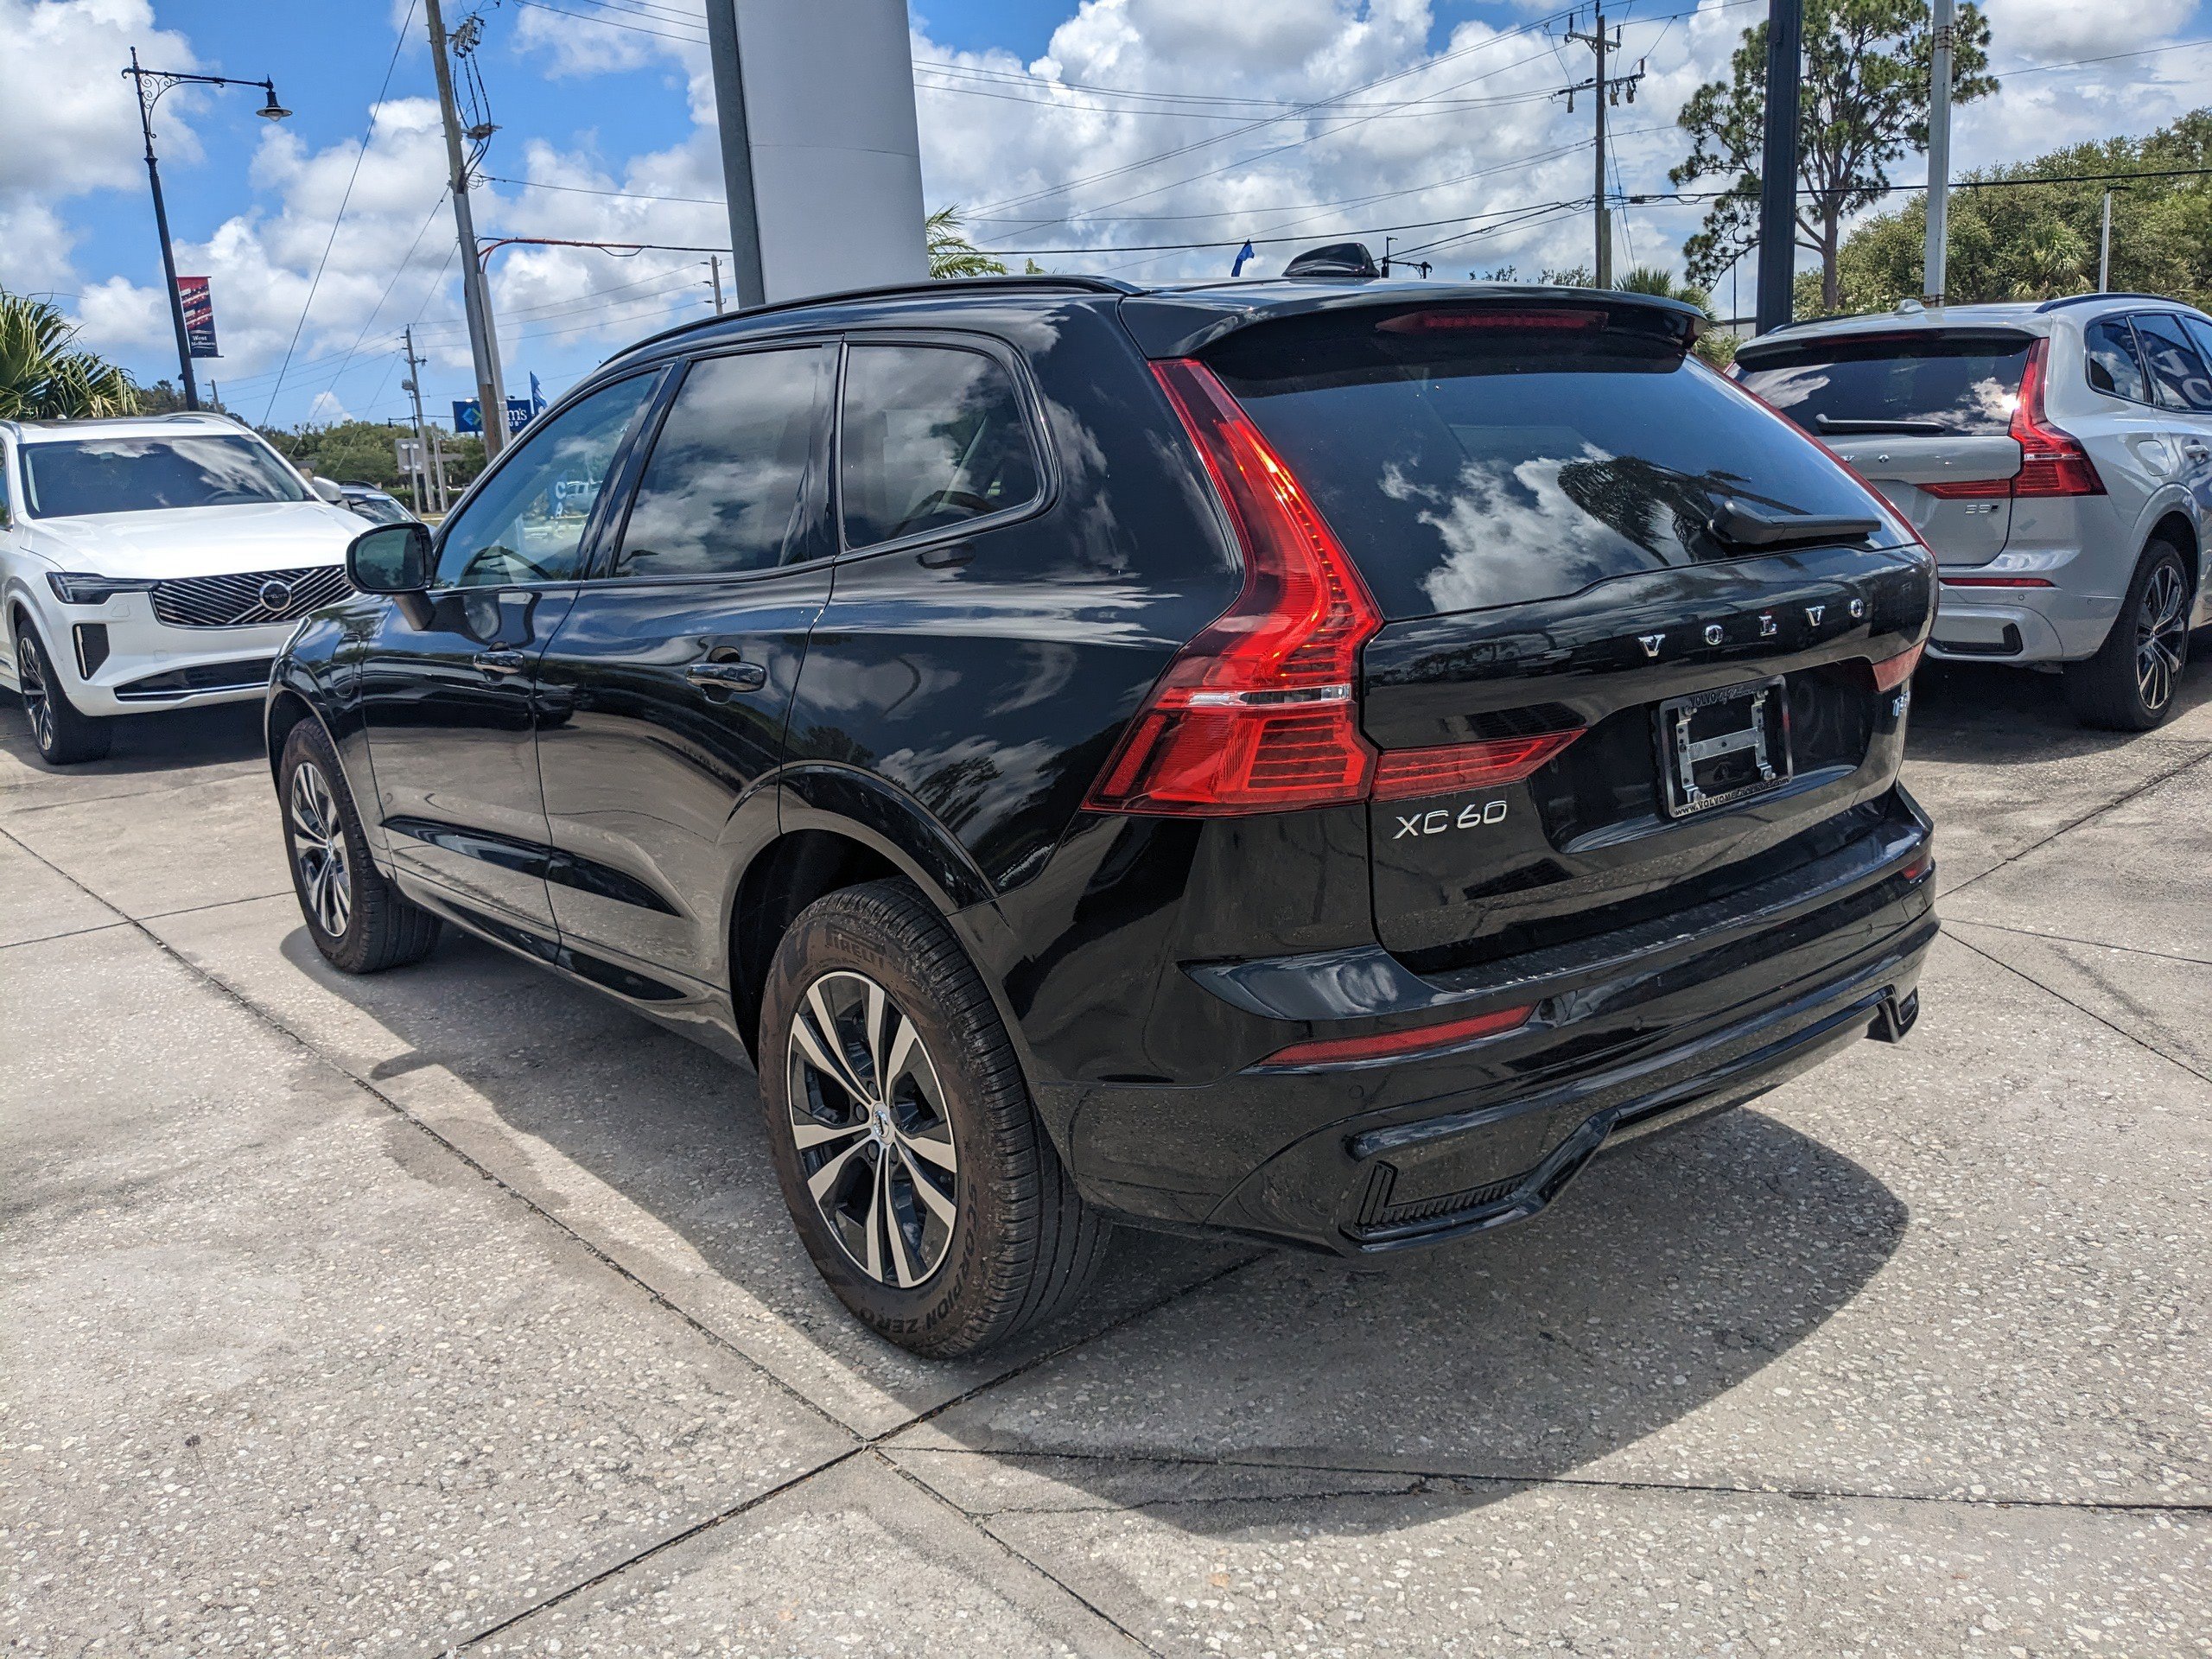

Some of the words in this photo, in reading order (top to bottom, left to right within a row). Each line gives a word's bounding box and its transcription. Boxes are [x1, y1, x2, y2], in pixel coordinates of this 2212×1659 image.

[507, 408, 528, 421] m's
[1637, 598, 1865, 658] VOLVO
[1690, 691, 1717, 708] VOLVO
[825, 921, 887, 968] PIRELLI
[859, 1306, 918, 1334] ZERO
